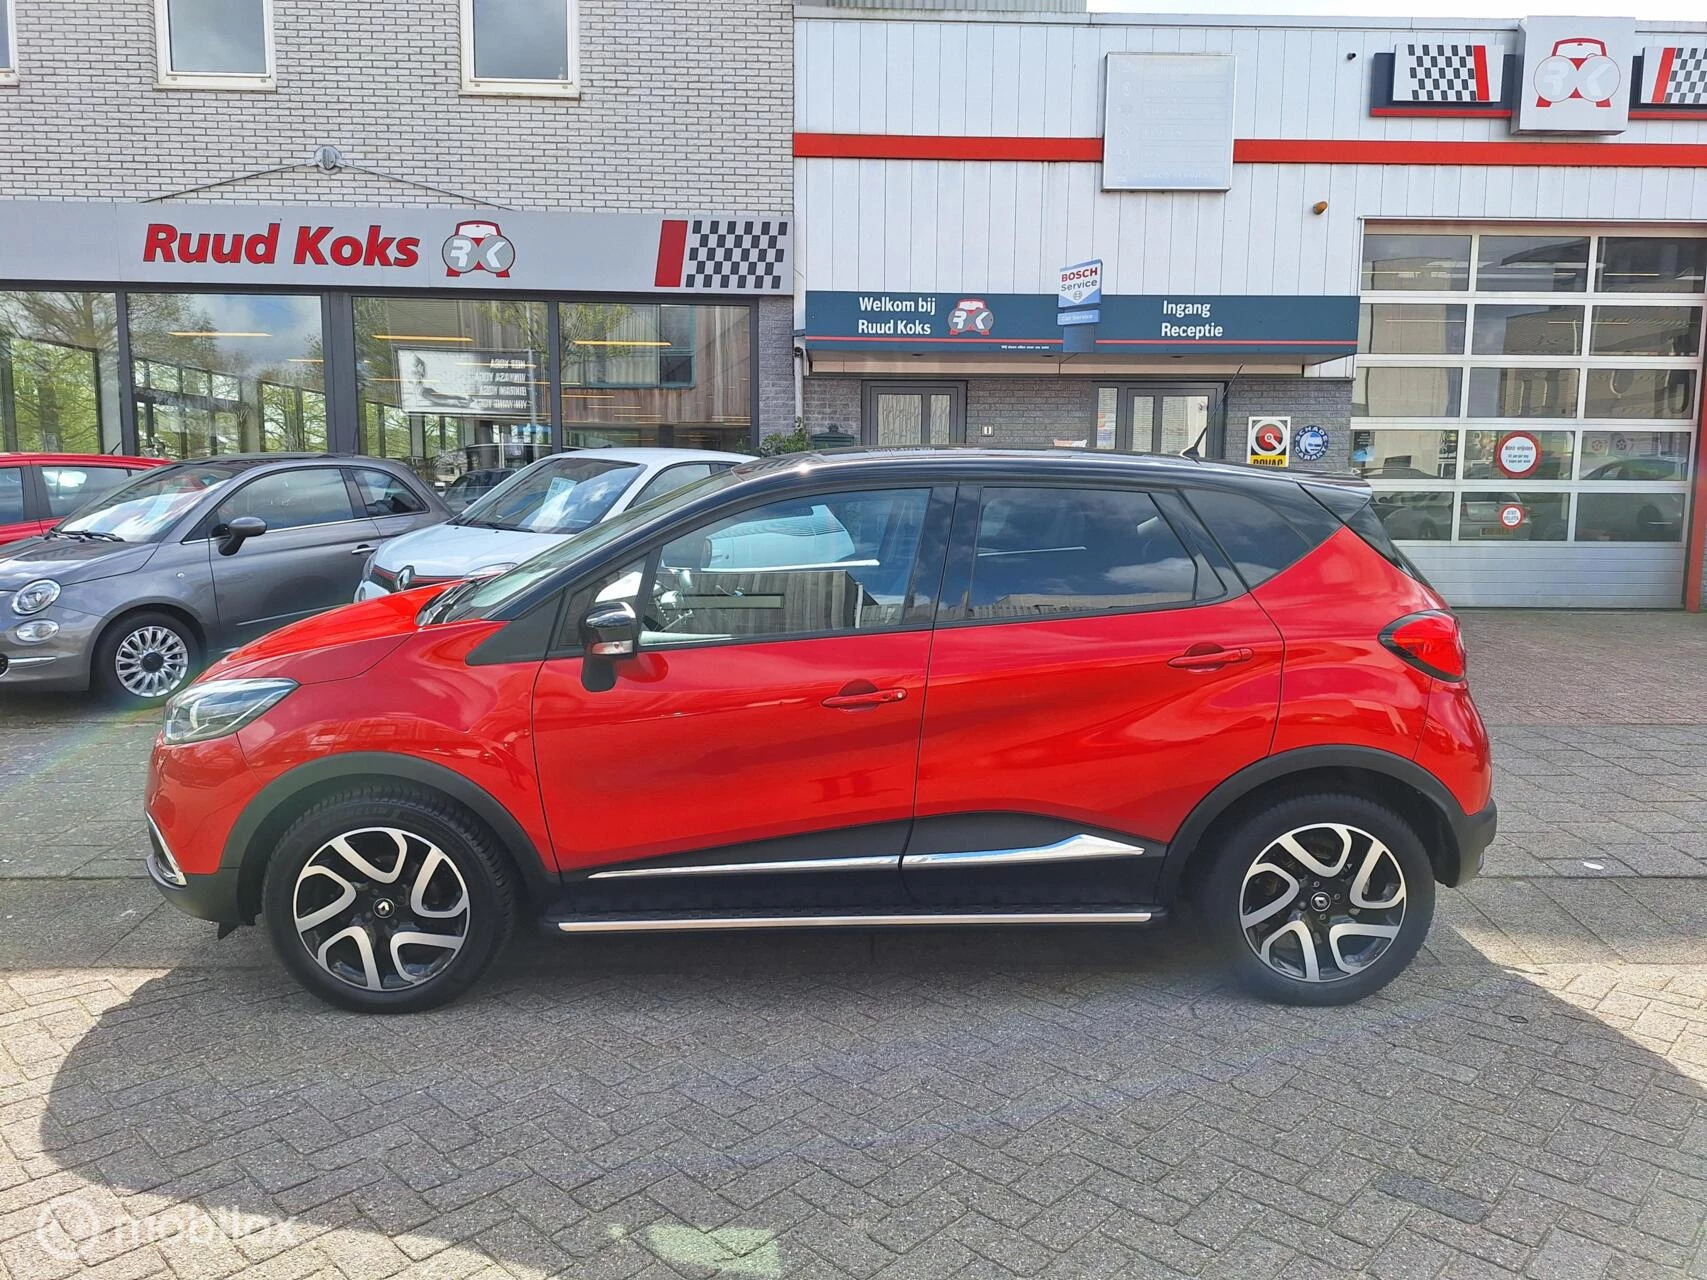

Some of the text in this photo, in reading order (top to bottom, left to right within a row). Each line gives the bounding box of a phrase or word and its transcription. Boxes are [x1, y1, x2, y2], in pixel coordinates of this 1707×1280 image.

[142, 223, 420, 268] Ruud Koks
[1061, 267, 1098, 282] BOSCH
[1060, 279, 1098, 292] Service
[859, 297, 936, 315] Welkom bij
[1163, 300, 1211, 318] Ingang
[858, 319, 931, 335] Ruud Koks
[1161, 322, 1224, 340] Receptie
